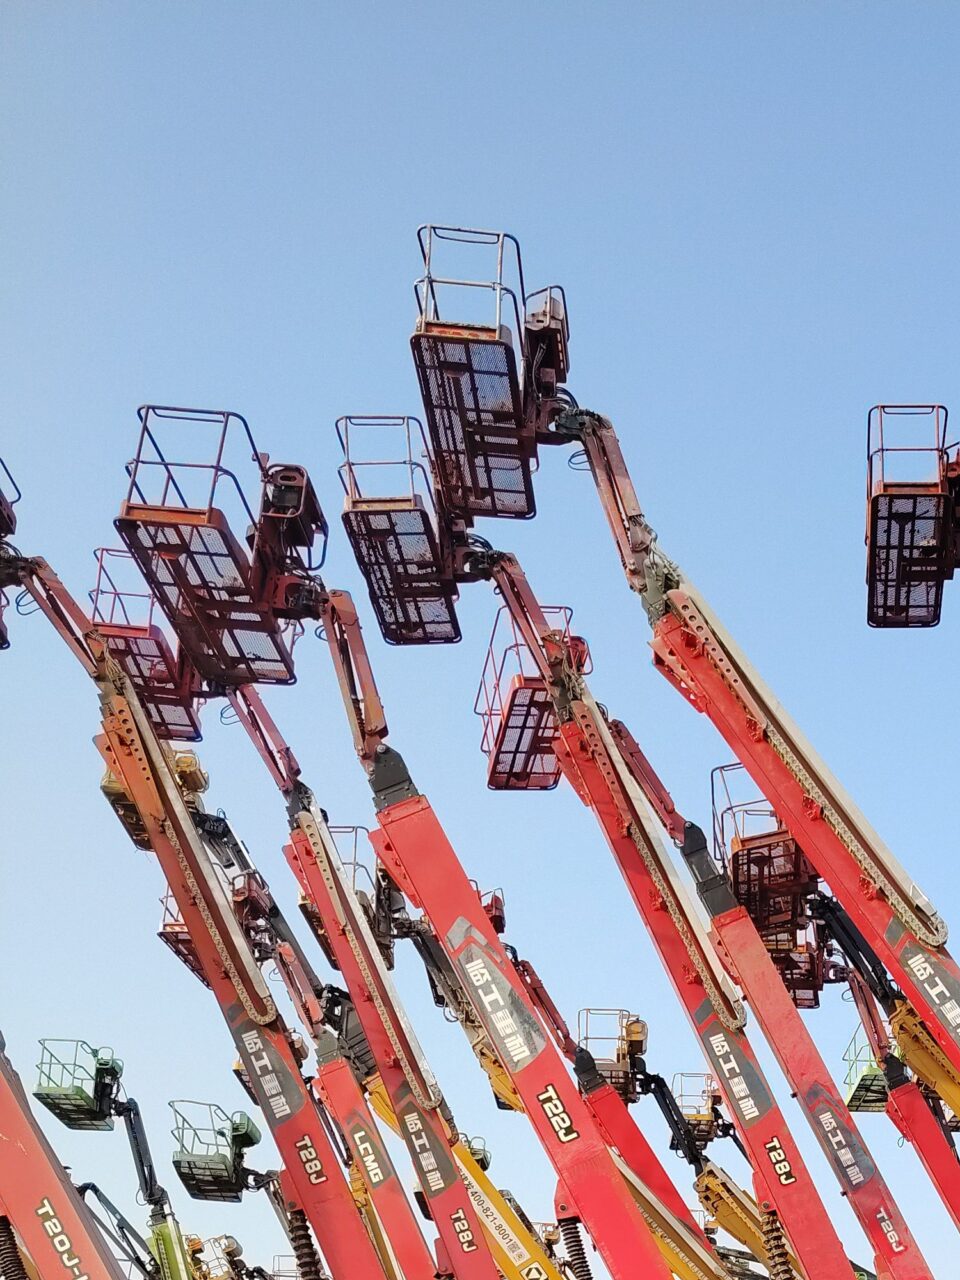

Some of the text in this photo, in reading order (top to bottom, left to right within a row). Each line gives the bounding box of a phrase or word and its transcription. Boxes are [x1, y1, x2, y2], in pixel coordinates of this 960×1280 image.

[464, 958, 530, 1062] 临工重机
[241, 1031, 292, 1119] 临工重机
[708, 1033, 759, 1121] 临工重机
[537, 1084, 580, 1143] T22J
[295, 1135, 327, 1187] T28J
[403, 1112, 446, 1191] 临工重机
[764, 1137, 796, 1186] T28J
[819, 1112, 864, 1186] 临工重机
[450, 1207, 478, 1252] T28J
[470, 1190, 512, 1245] 400-821-8001
[876, 1207, 905, 1252] T26J
